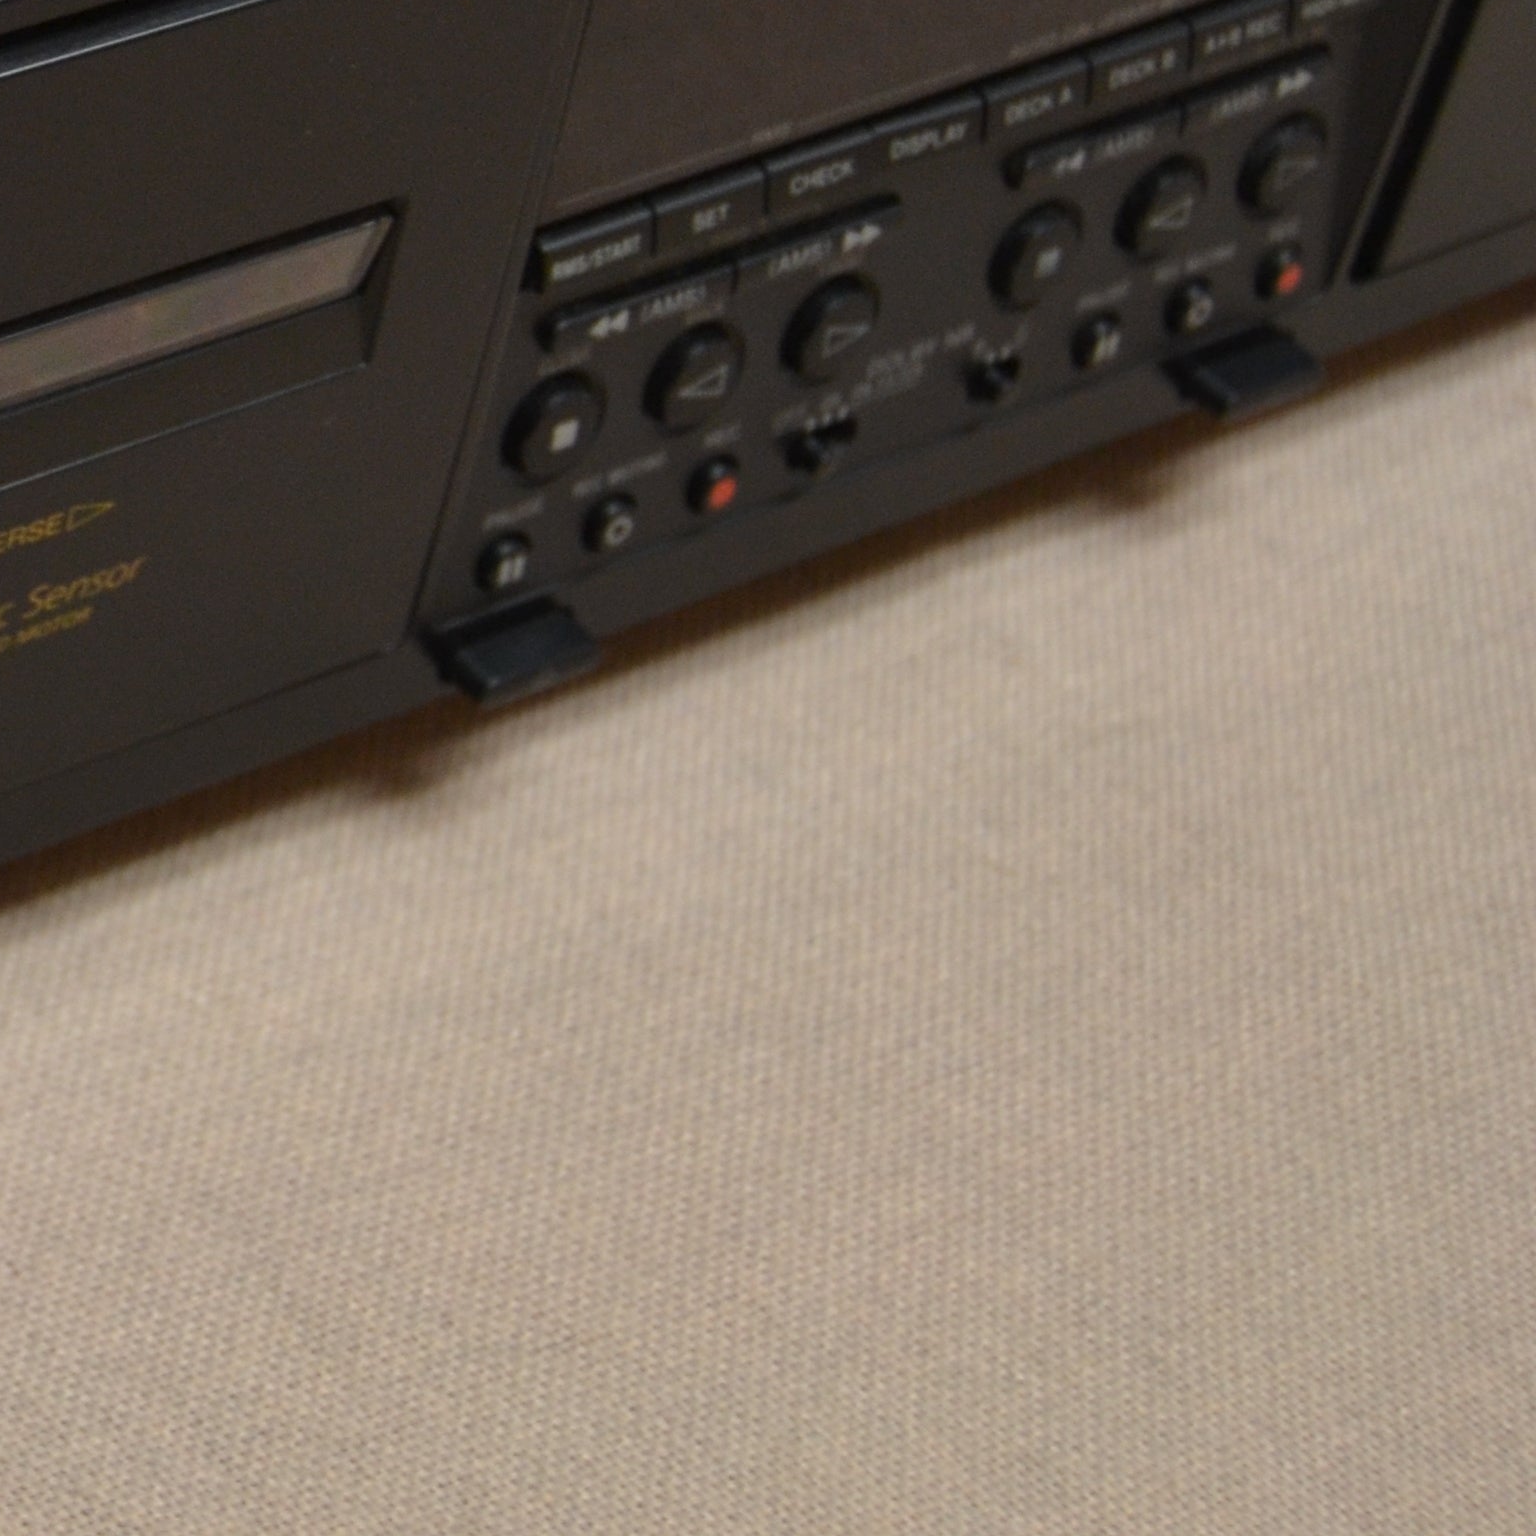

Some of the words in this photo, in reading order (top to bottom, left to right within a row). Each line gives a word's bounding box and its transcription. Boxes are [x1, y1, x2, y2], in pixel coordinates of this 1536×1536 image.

[1108, 56, 1157, 90] DECK
[1003, 93, 1054, 126] DECK
[1057, 85, 1073, 106] A
[888, 122, 969, 161] DISPLAY
[787, 159, 857, 197] CHECK
[690, 202, 731, 234] SET
[22, 554, 149, 620] Sensor
